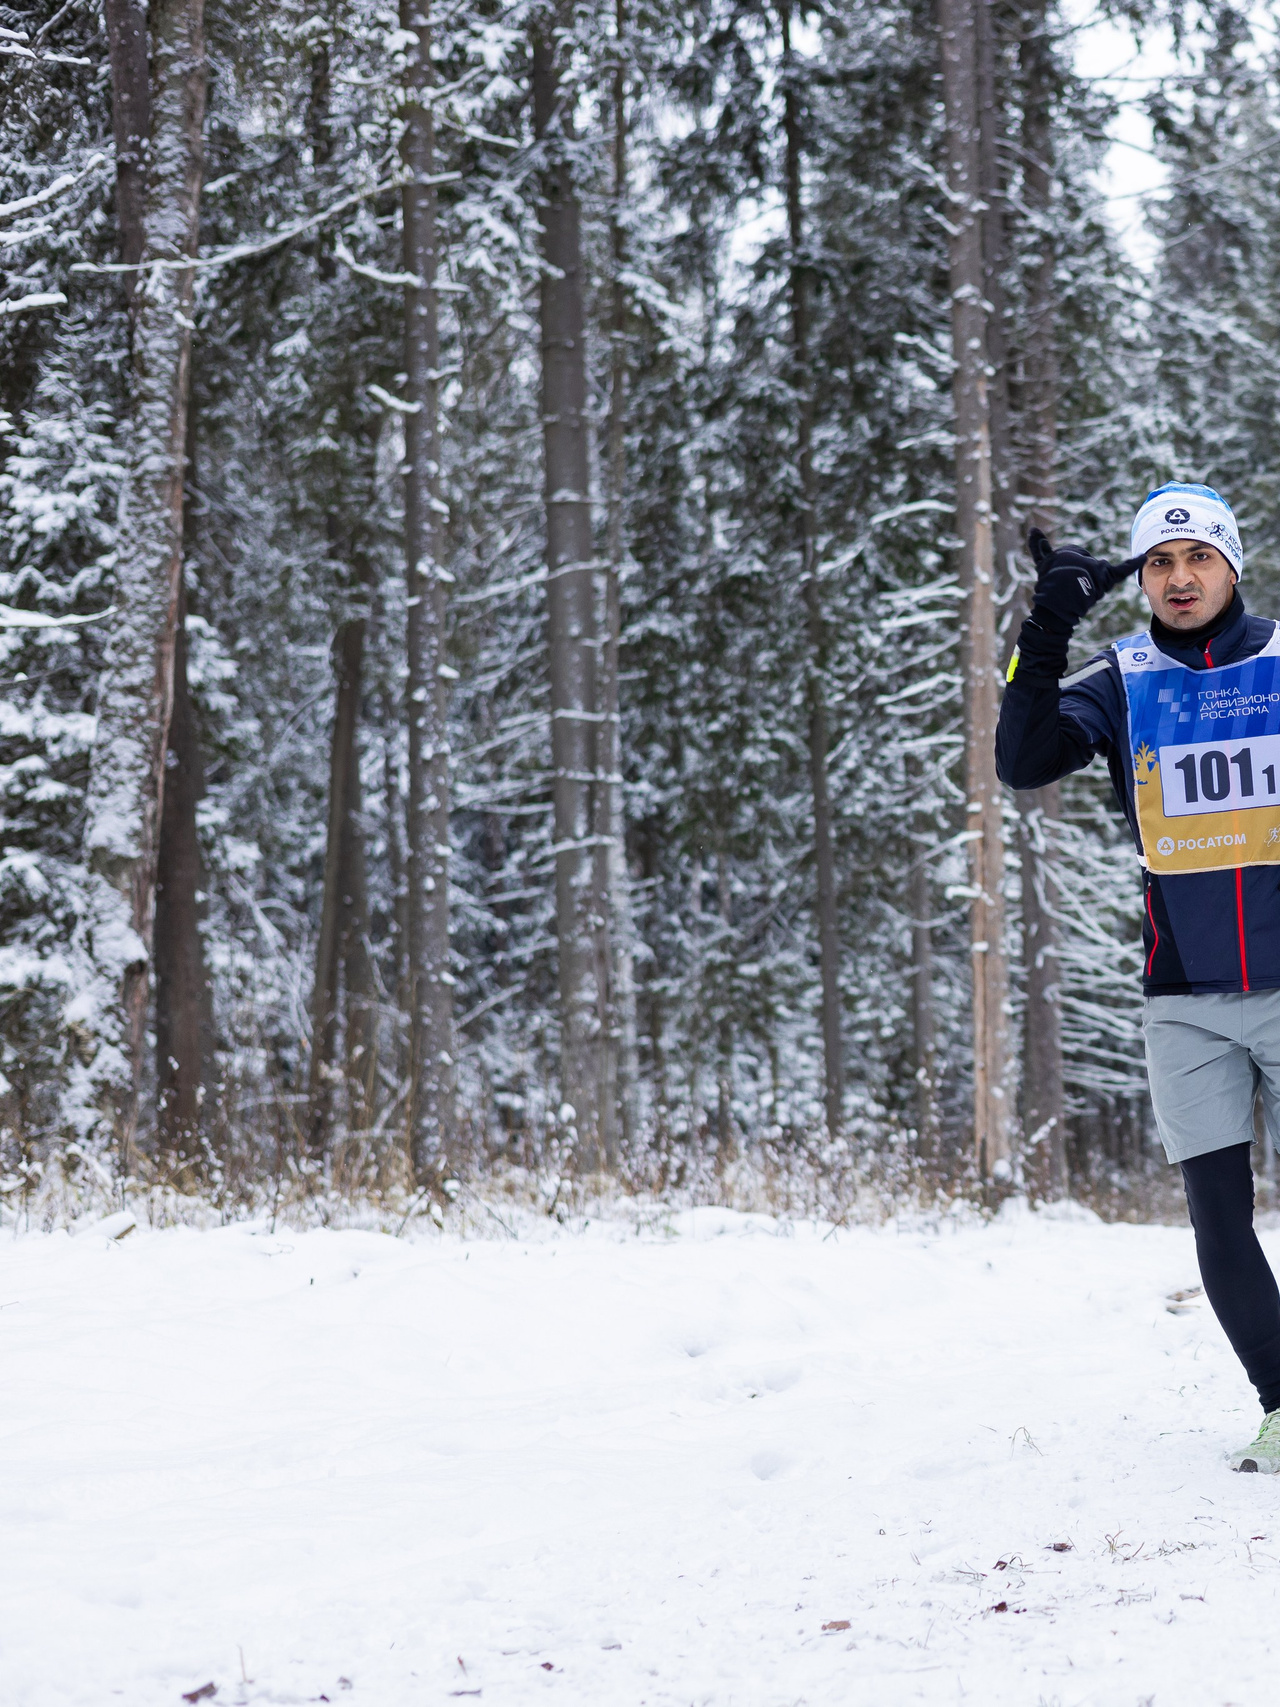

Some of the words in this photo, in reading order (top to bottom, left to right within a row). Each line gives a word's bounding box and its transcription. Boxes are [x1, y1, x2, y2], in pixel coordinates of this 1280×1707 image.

[1161, 527, 1196, 535] РОСАТОМ
[1197, 686, 1241, 700] ГОНКА
[1200, 705, 1270, 721] РОСАТОМА
[1174, 747, 1255, 804] 101
[1262, 764, 1276, 795] 1
[1177, 833, 1247, 851] РОСАТОМ
